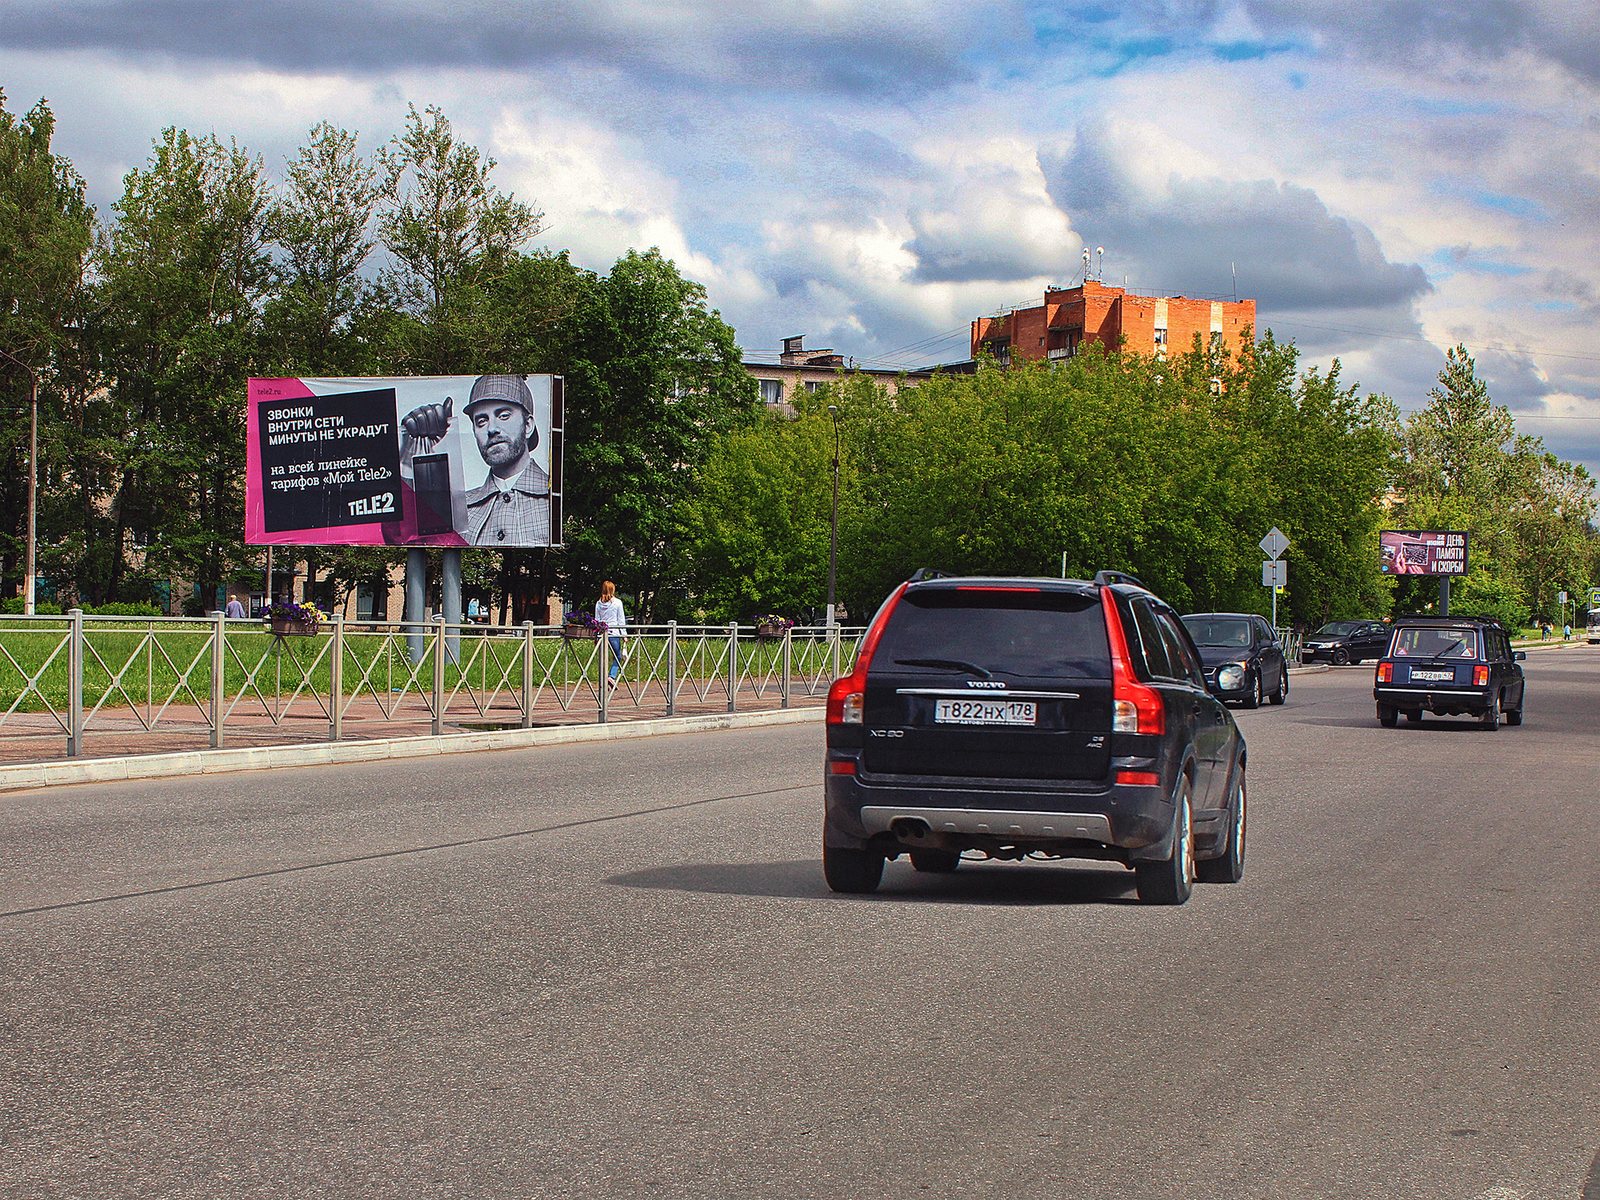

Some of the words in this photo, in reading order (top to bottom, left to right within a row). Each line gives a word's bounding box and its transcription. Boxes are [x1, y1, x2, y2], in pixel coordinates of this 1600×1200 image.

[267, 406, 314, 421] ЗВОНКИ
[268, 419, 313, 434] ВНУТРИ
[314, 416, 344, 429] СЕТИ
[268, 431, 318, 446] МИНУТЫ
[320, 429, 334, 441] НЕ
[337, 423, 389, 439] УКРАДУТ
[270, 465, 285, 476] на
[288, 460, 315, 474] всей
[318, 456, 368, 471] линейке
[270, 475, 320, 492] тарифов
[322, 471, 355, 485] «Мой
[357, 467, 392, 481] Tele2»
[347, 492, 395, 516] TELE2
[1446, 534, 1465, 547] ДЕНЬ
[1436, 547, 1464, 560] ПАМЯТИ
[1431, 561, 1437, 573] И
[1438, 561, 1464, 573] СКОРБИ
[941, 702, 1005, 719] Т822НХ
[1008, 703, 1032, 716] 178
